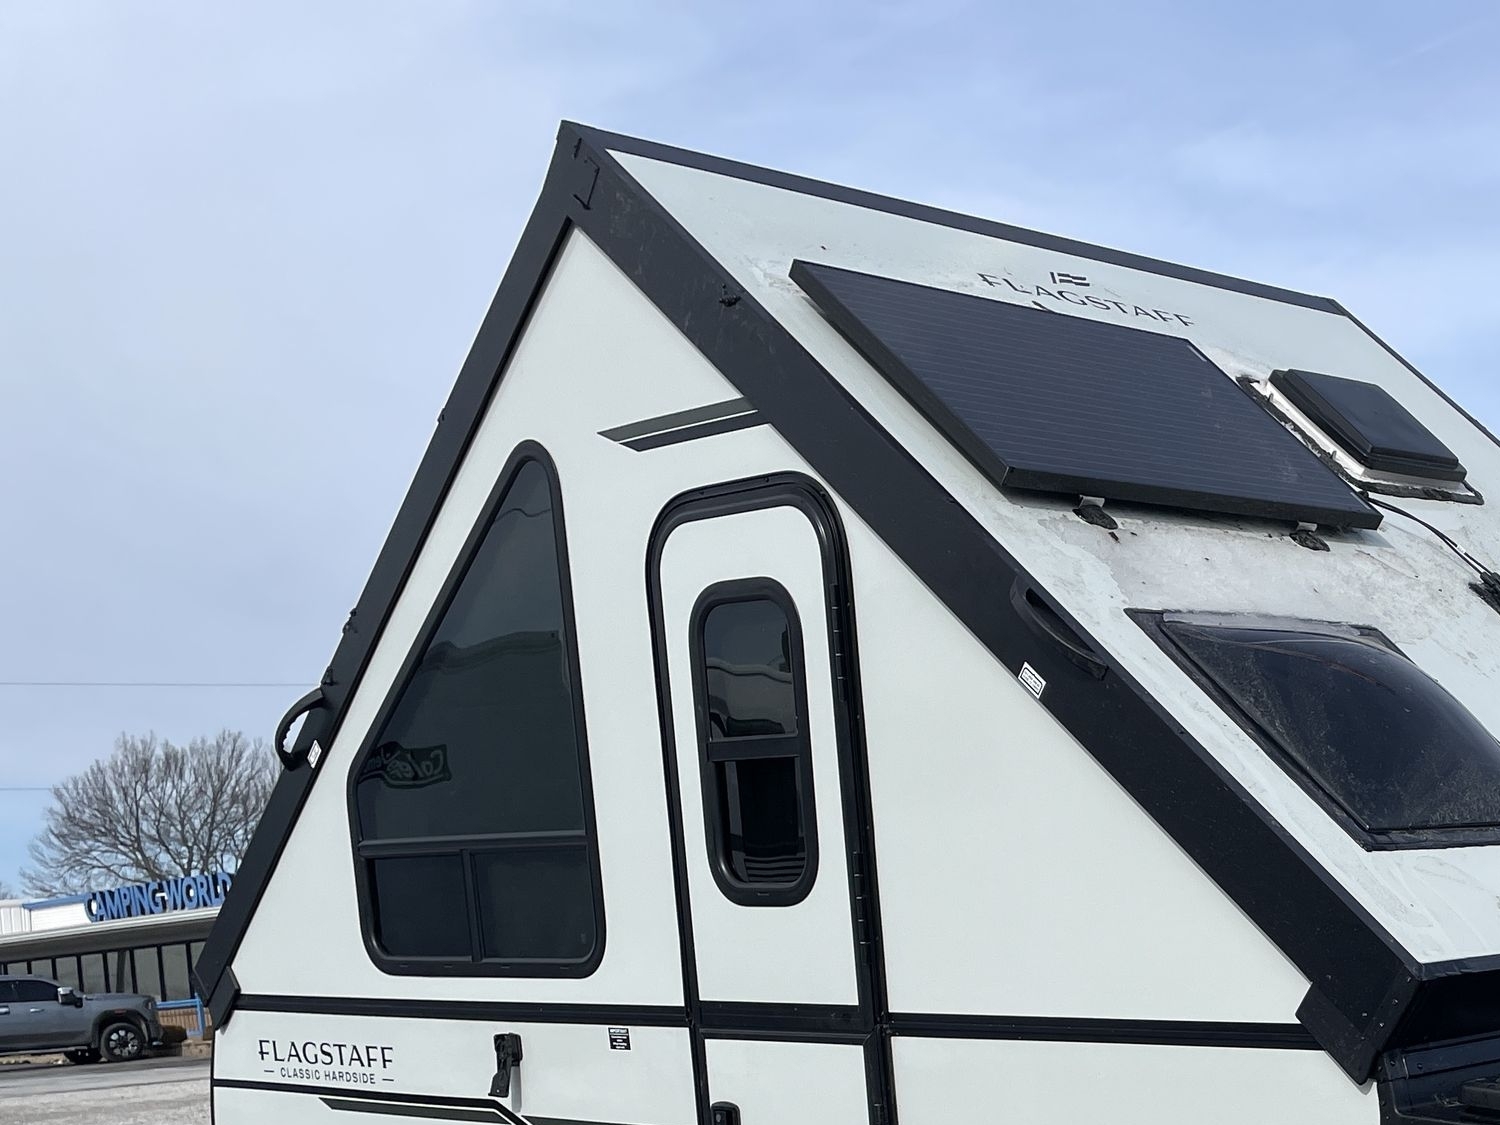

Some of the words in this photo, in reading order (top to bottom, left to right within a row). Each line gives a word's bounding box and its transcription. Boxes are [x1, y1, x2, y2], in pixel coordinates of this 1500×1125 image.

[976, 272, 1195, 327] FLAGSTAFF
[85, 881, 164, 923] CAMPING
[163, 871, 233, 912] WORLD
[257, 1038, 394, 1069] FLAGSTAFF
[279, 1067, 321, 1081] CLASSIC
[324, 1070, 376, 1085] HARDSIDE
